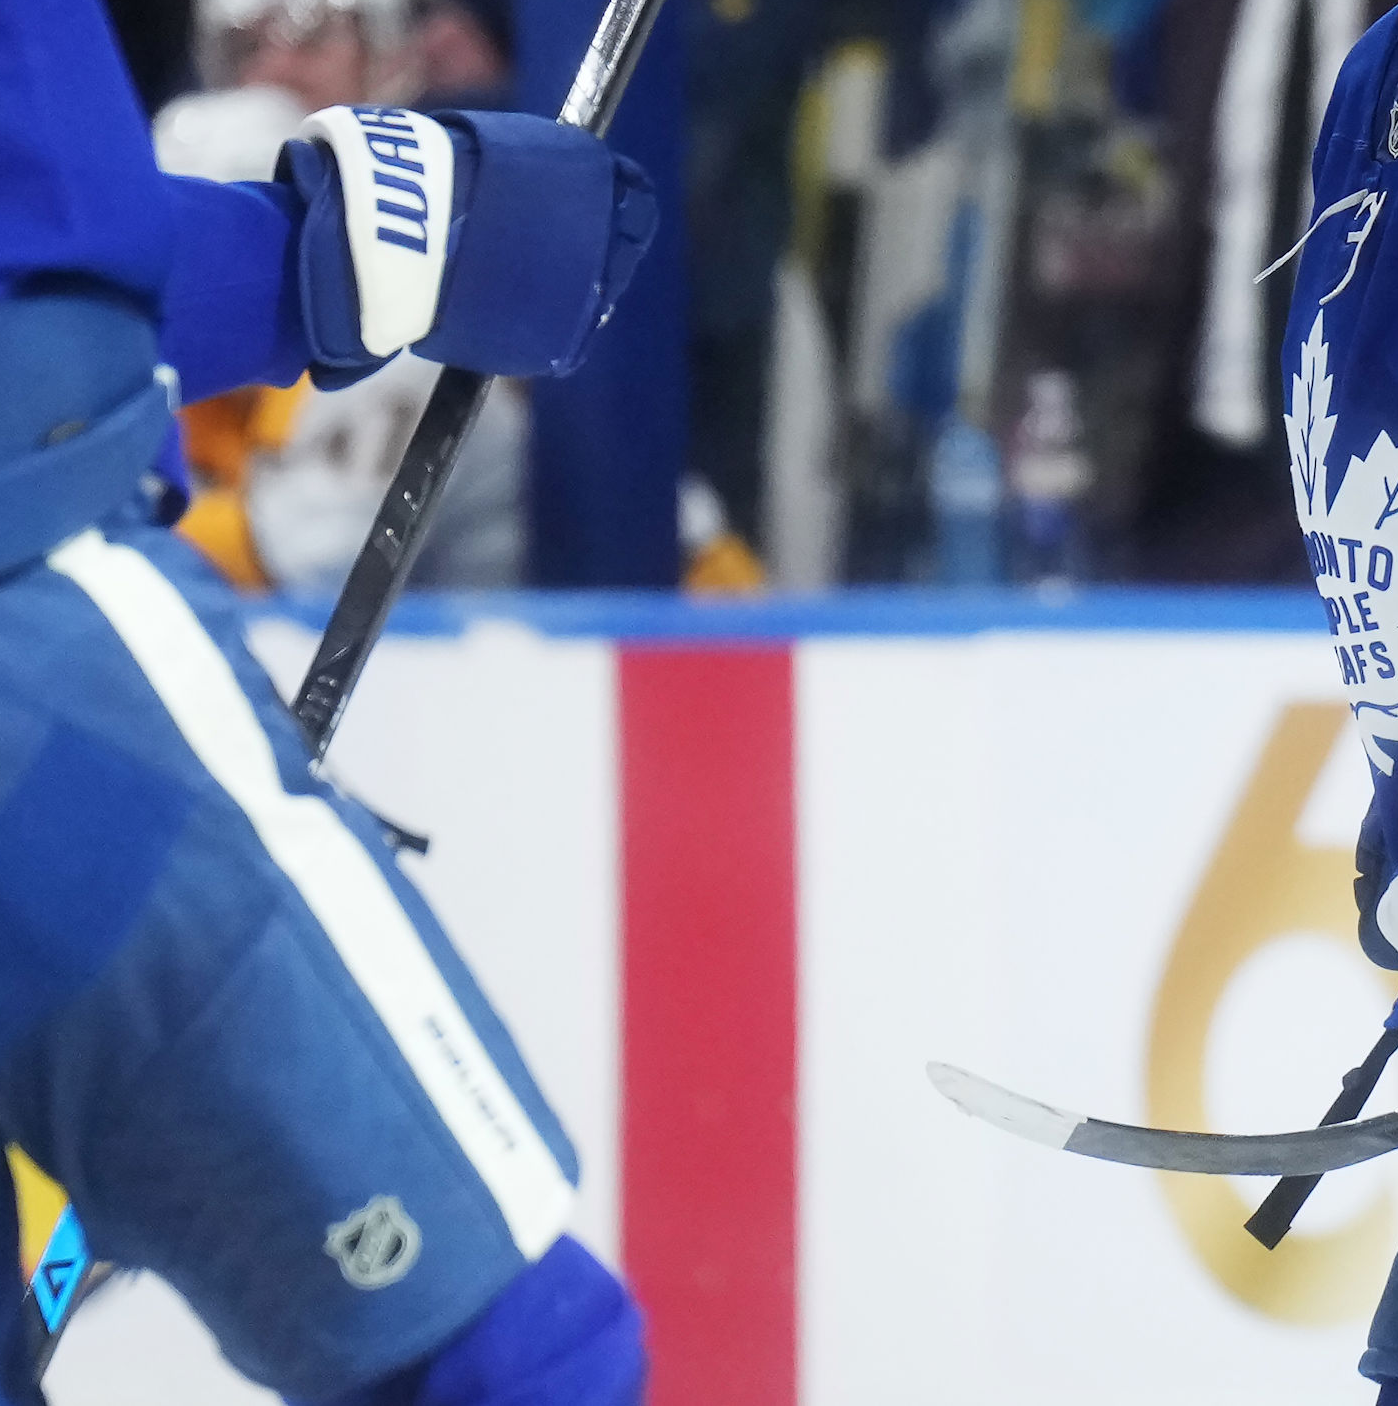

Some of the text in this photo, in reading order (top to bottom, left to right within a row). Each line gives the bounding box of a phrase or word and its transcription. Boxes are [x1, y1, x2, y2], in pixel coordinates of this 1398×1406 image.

[1303, 530, 1393, 591] ONTO
[1323, 591, 1379, 635] PLE
[1335, 641, 1395, 685] AFS
